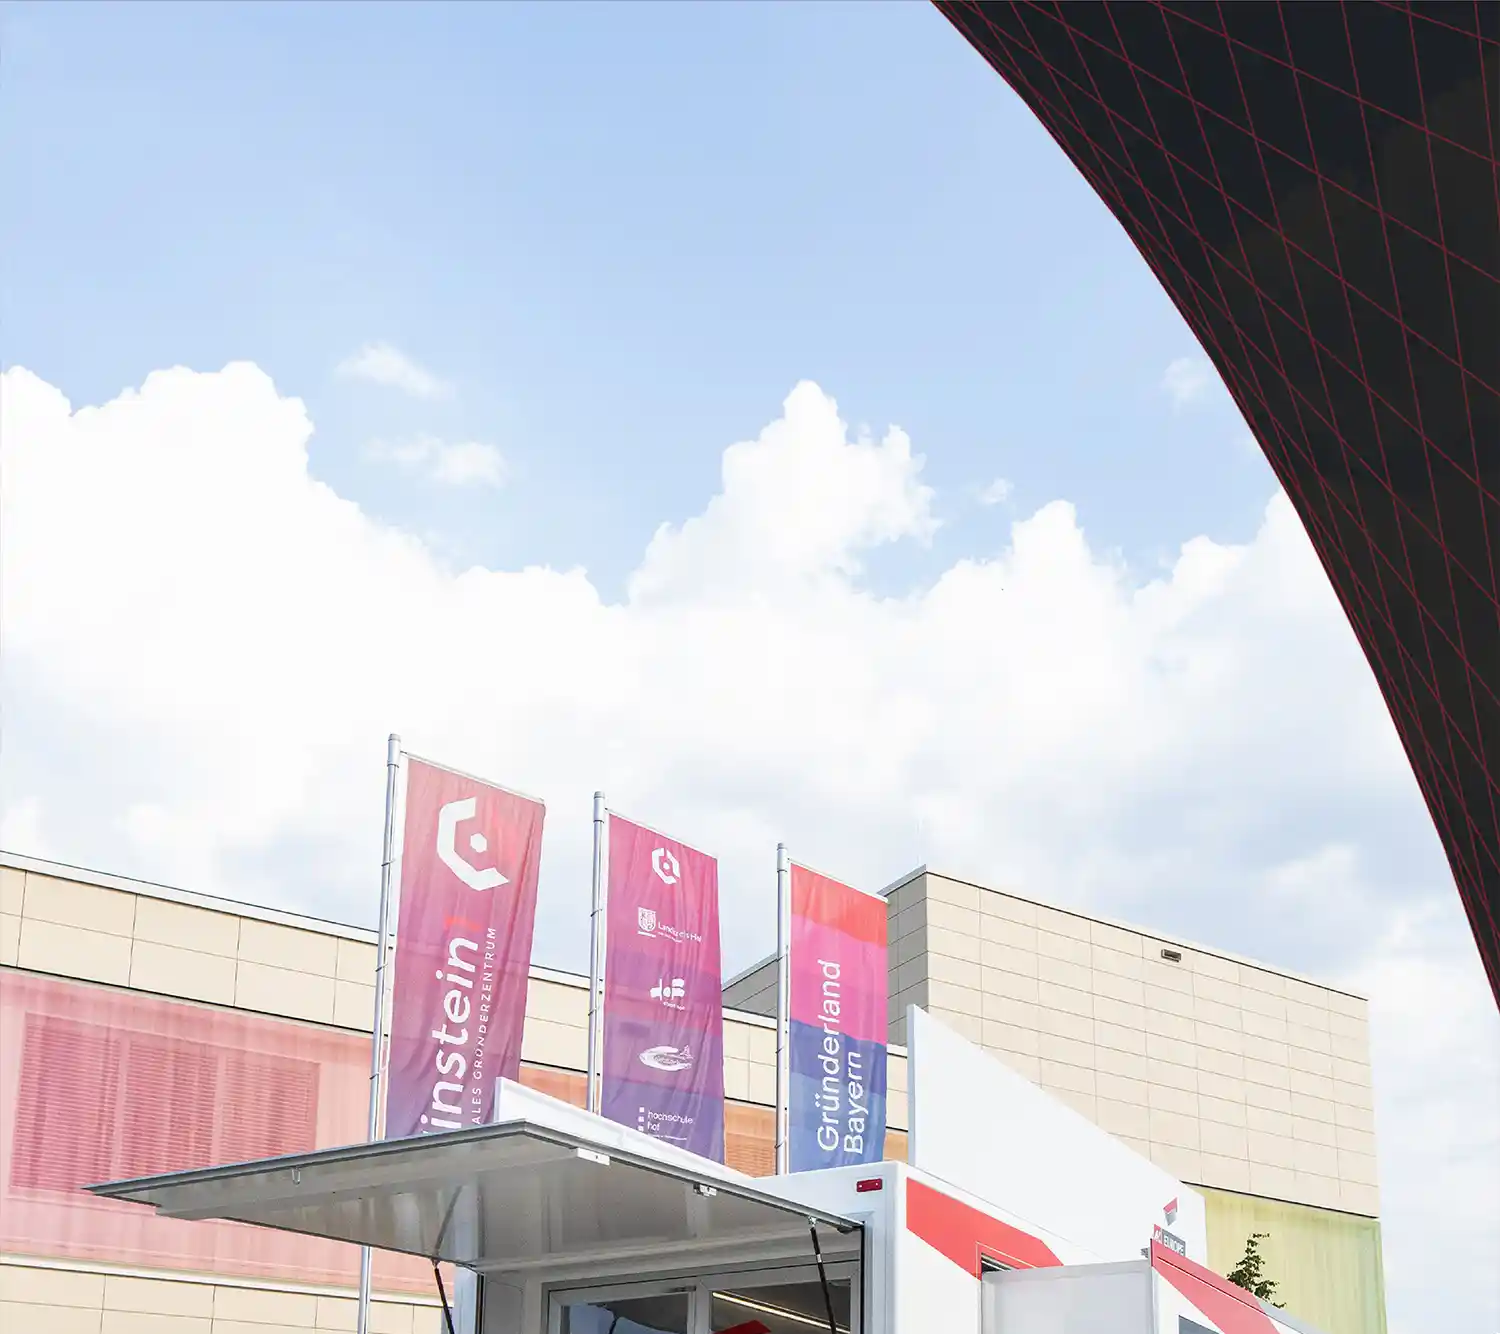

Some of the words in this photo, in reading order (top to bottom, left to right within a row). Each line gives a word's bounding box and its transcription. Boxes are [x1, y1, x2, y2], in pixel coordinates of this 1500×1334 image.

[815, 959, 841, 1151] Gründerland
[844, 1051, 869, 1155] Bayern
[648, 1109, 694, 1125] hochschule
